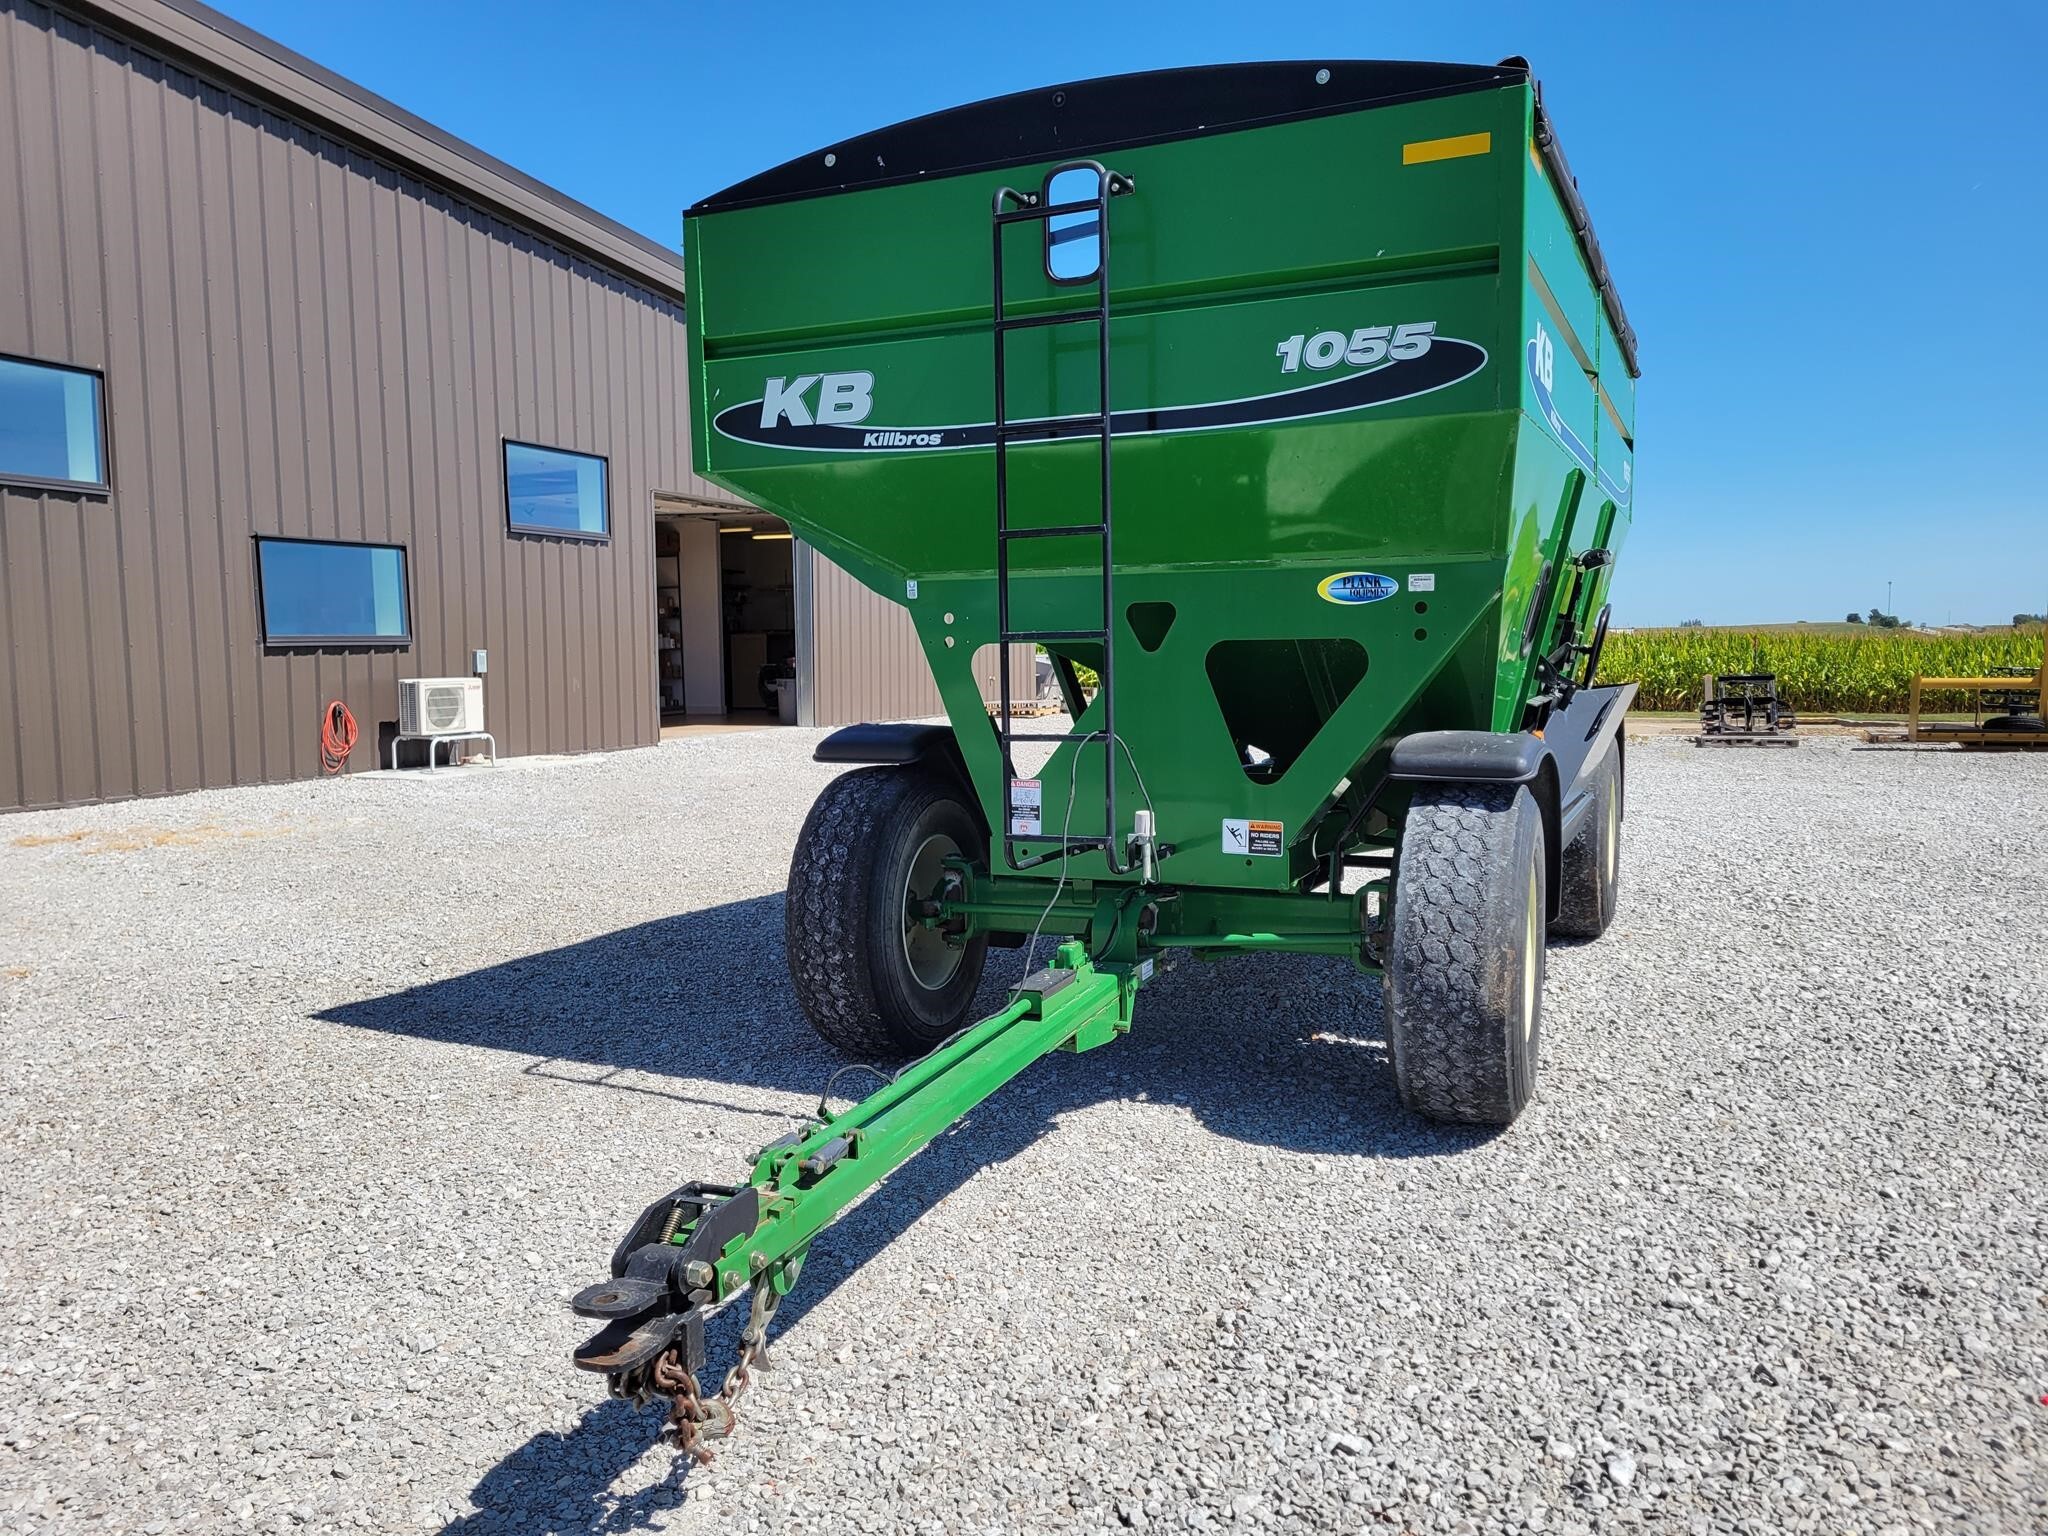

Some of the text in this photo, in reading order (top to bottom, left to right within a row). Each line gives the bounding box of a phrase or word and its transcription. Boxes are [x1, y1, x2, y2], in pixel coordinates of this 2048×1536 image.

[1276, 321, 1437, 373] 1055
[1535, 321, 1553, 393] KB
[760, 369, 875, 428] KB
[863, 431, 943, 447] Killbros
[1342, 576, 1382, 588] PLANK
[1349, 588, 1389, 597] EQUIPMENT
